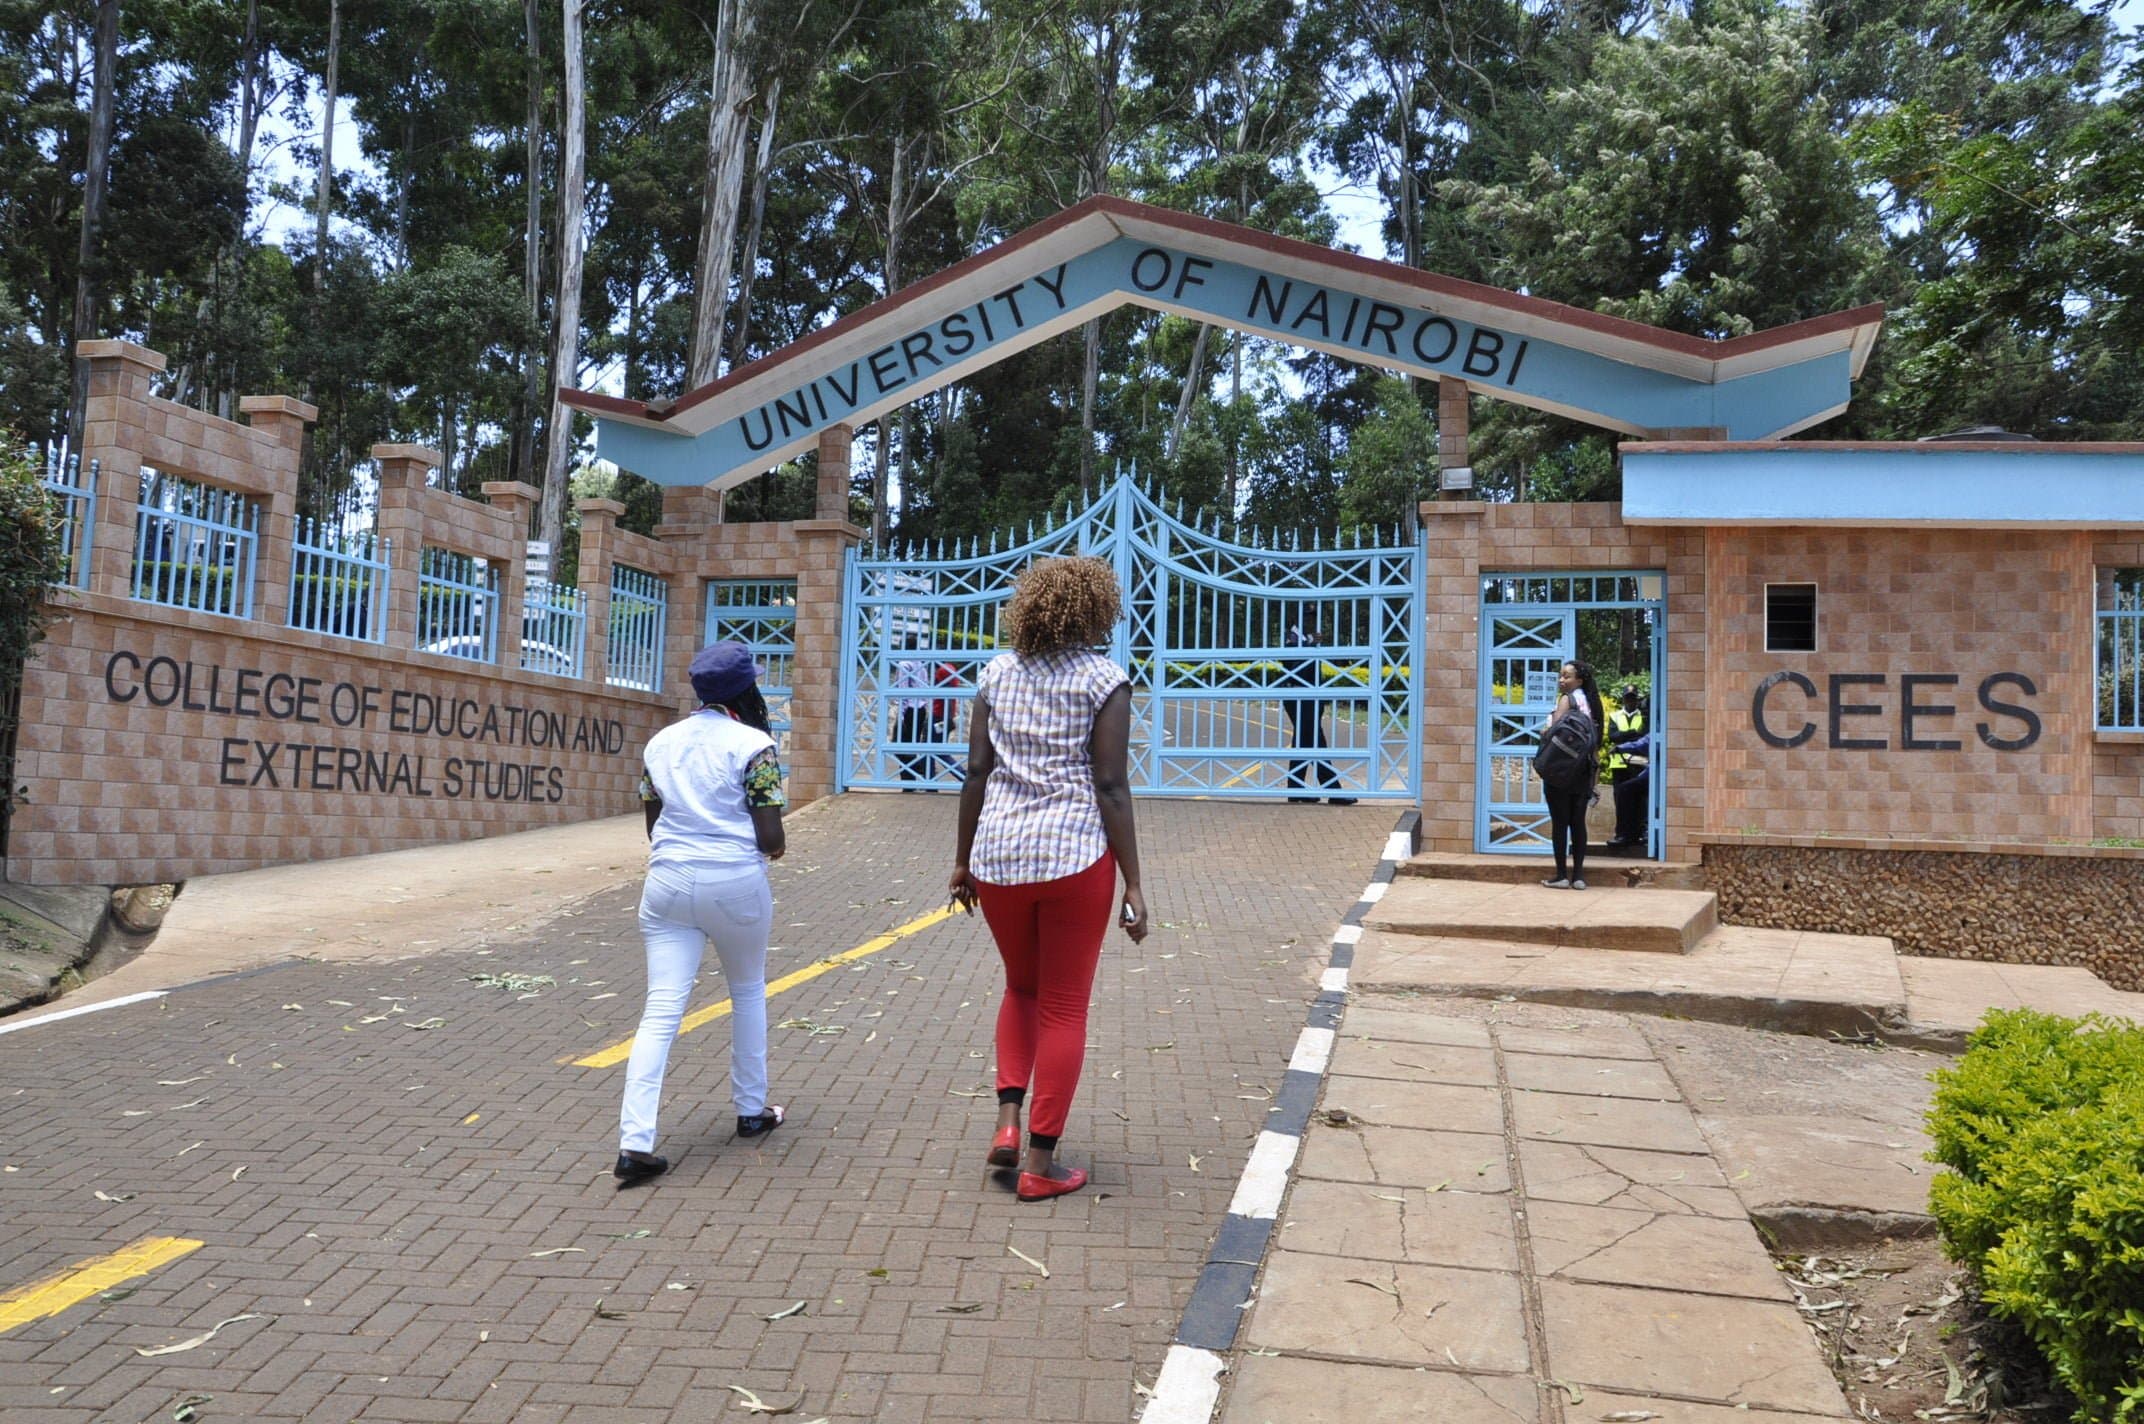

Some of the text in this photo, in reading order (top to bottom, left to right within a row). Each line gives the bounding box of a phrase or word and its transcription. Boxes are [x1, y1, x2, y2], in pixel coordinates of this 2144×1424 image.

[739, 248, 1529, 451] UNIVERSITY OF NAIROBI
[105, 651, 624, 754] COLLEGE OF EDUCATION AND
[1752, 671, 2042, 751] CEES
[220, 738, 563, 802] EXTERNAL STUDIES
